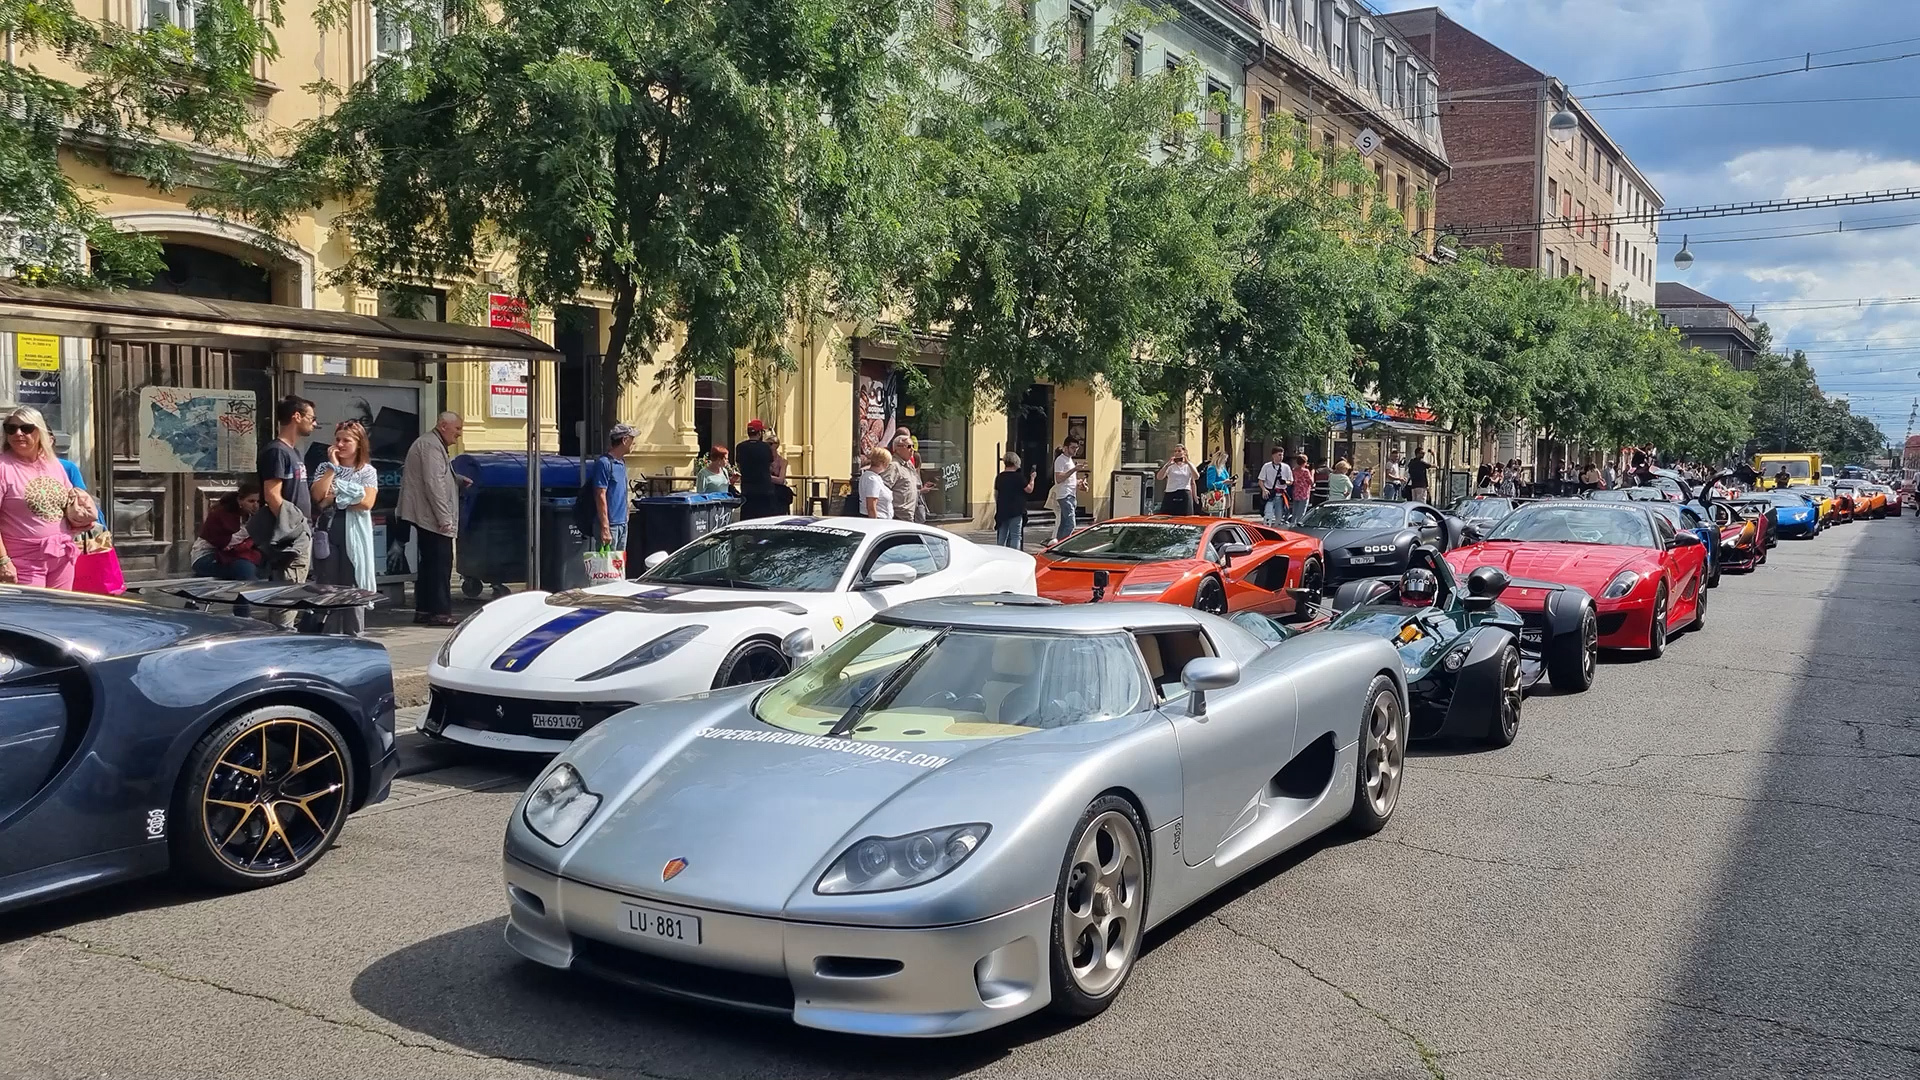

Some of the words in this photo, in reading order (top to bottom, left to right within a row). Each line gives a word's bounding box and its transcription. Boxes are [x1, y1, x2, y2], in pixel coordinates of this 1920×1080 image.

[1362, 136, 1372, 149] S
[942, 462, 962, 479] 100%
[1527, 503, 1637, 512] SUPERCAROWNERSCIRCLE.COM
